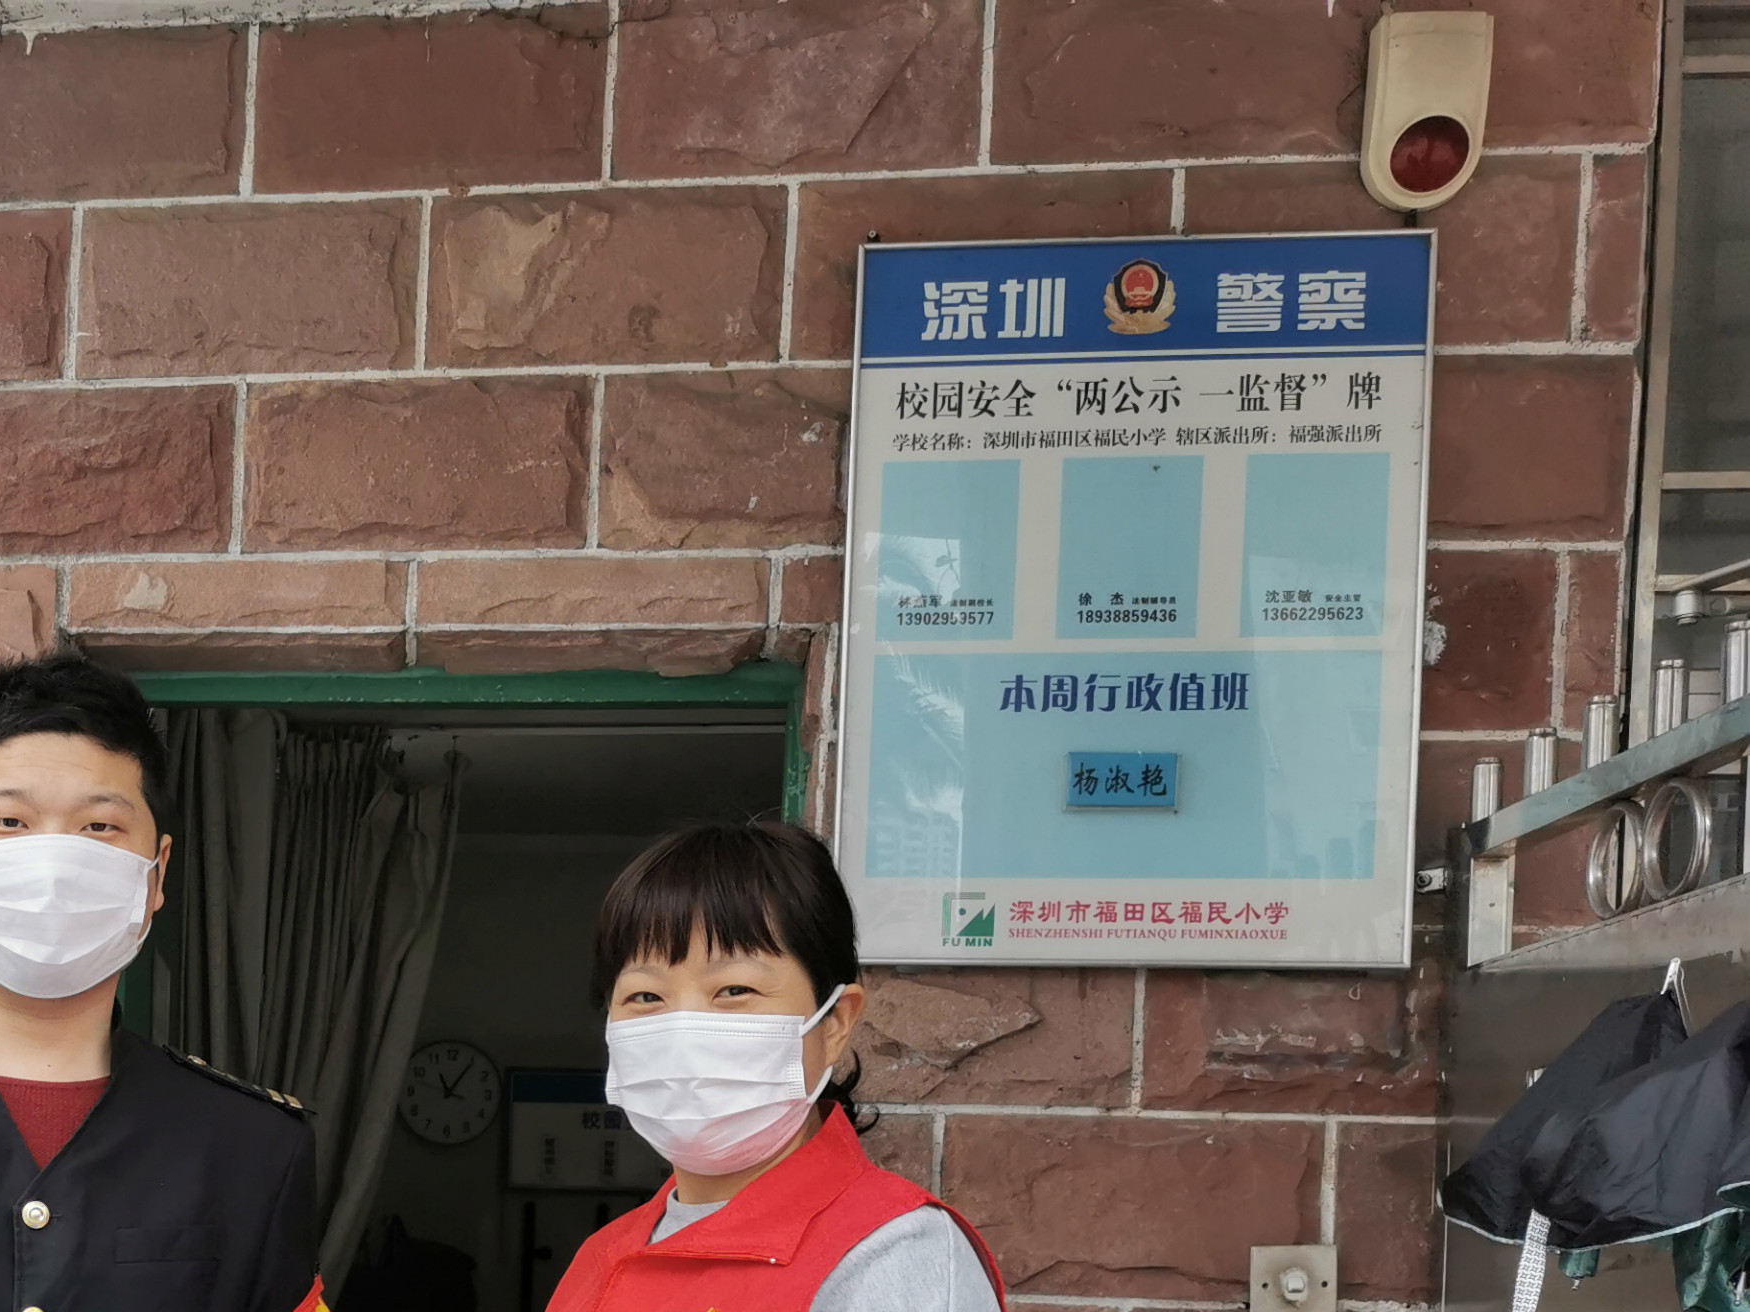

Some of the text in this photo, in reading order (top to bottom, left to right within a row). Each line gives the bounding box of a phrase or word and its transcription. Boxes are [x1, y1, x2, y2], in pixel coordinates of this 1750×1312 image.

[921, 270, 1367, 341] 深圳 警察
[1264, 589, 1313, 603] 沈亚敏
[1077, 608, 1177, 624] 18938859436
[1261, 606, 1364, 621] 13662295623
[998, 671, 1250, 713] 本周行政值班
[1073, 762, 1168, 796] 杨淑艳
[1008, 900, 1290, 924] 深圳市福田区福民小学
[942, 937, 993, 948] FU MIN
[1008, 928, 1288, 941] SHENZHENSHI FUTIANQU FUMINXIAOXUE
